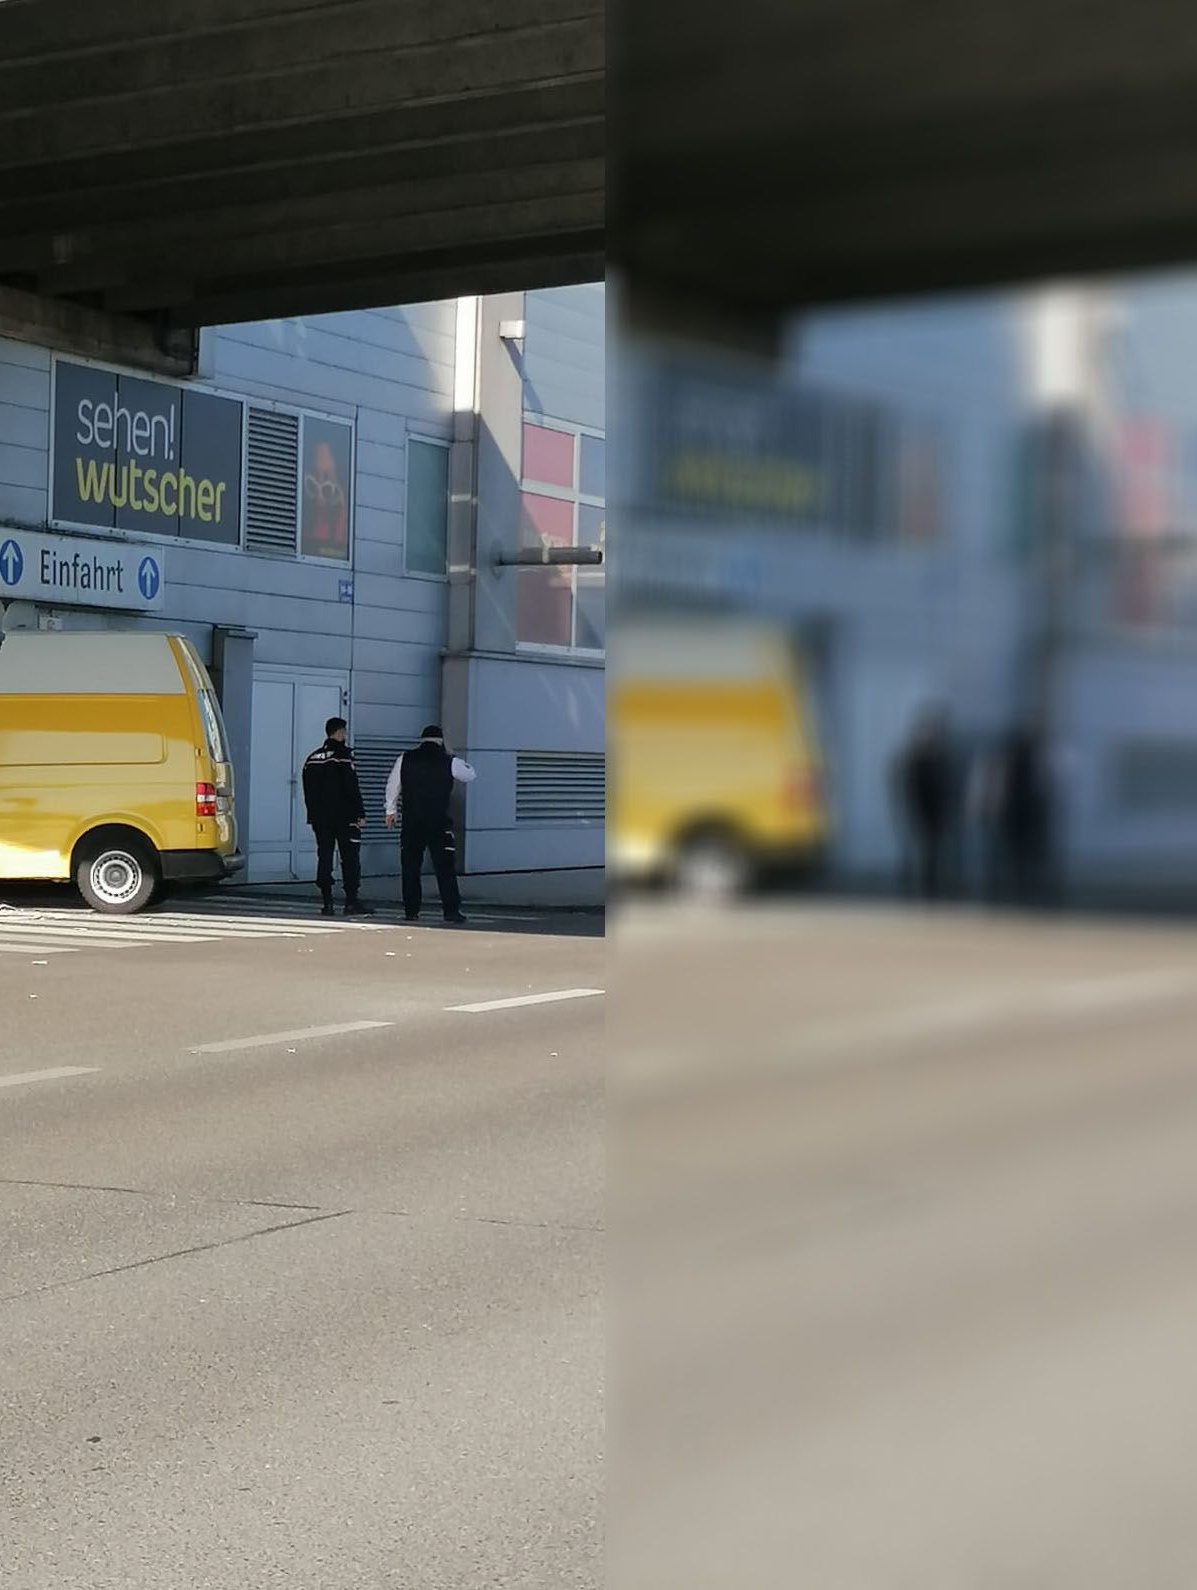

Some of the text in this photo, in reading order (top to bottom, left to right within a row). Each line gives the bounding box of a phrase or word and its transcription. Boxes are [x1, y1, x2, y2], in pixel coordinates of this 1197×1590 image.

[76, 388, 176, 461] sehen!
[75, 457, 226, 523] wutscher
[39, 549, 124, 593] Einfahrt
